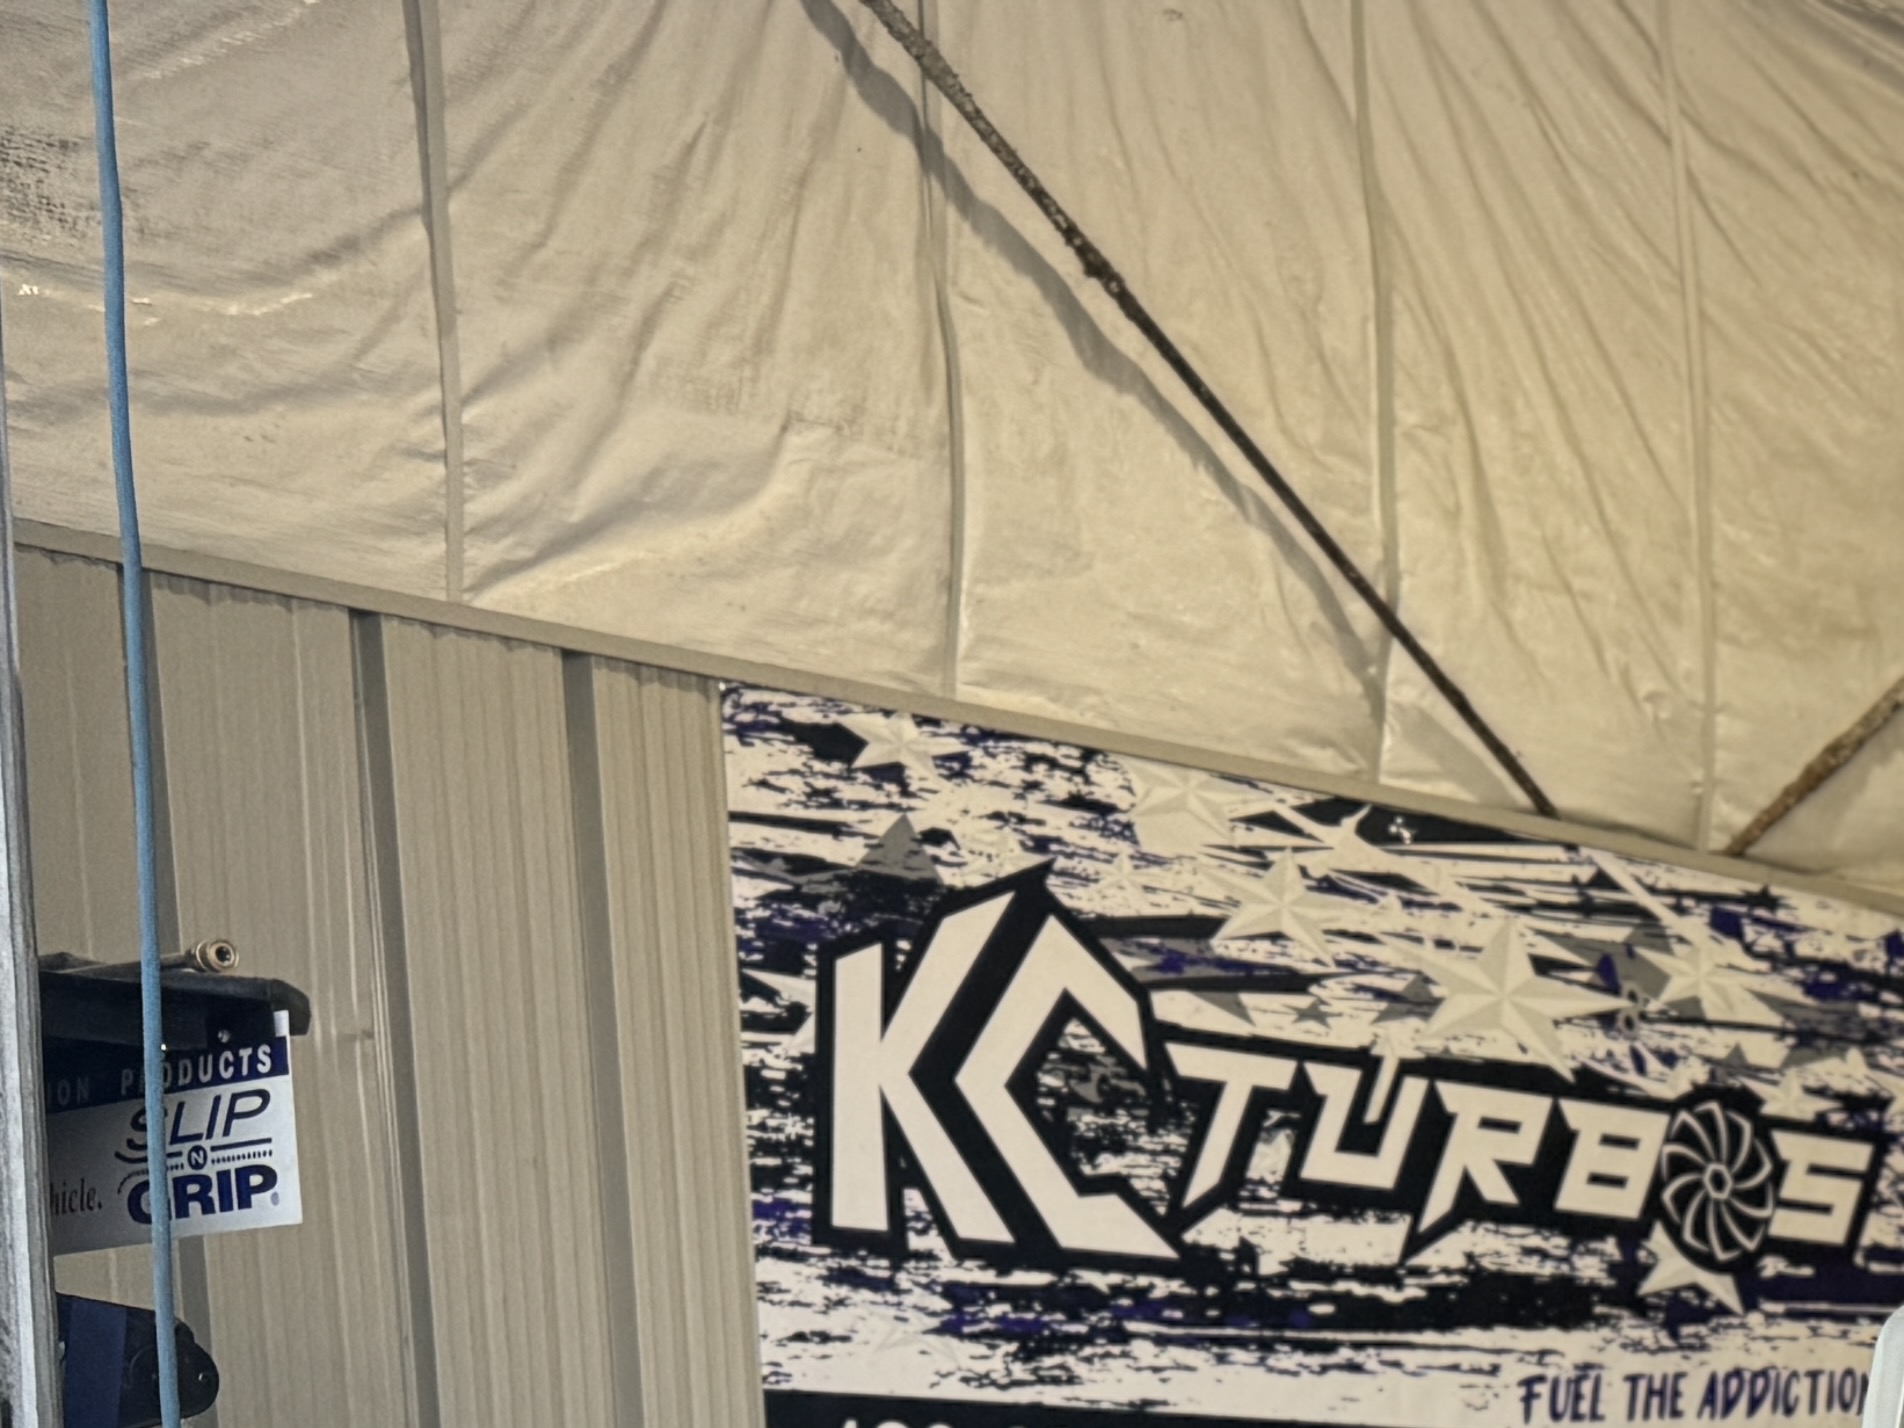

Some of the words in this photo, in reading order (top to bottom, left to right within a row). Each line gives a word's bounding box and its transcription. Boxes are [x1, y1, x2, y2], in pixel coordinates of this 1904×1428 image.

[120, 1043, 272, 1096] PODUCTS
[832, 890, 1180, 1260] KC
[1517, 1372, 1606, 1425] FUEL
[1622, 1370, 1690, 1423] THE
